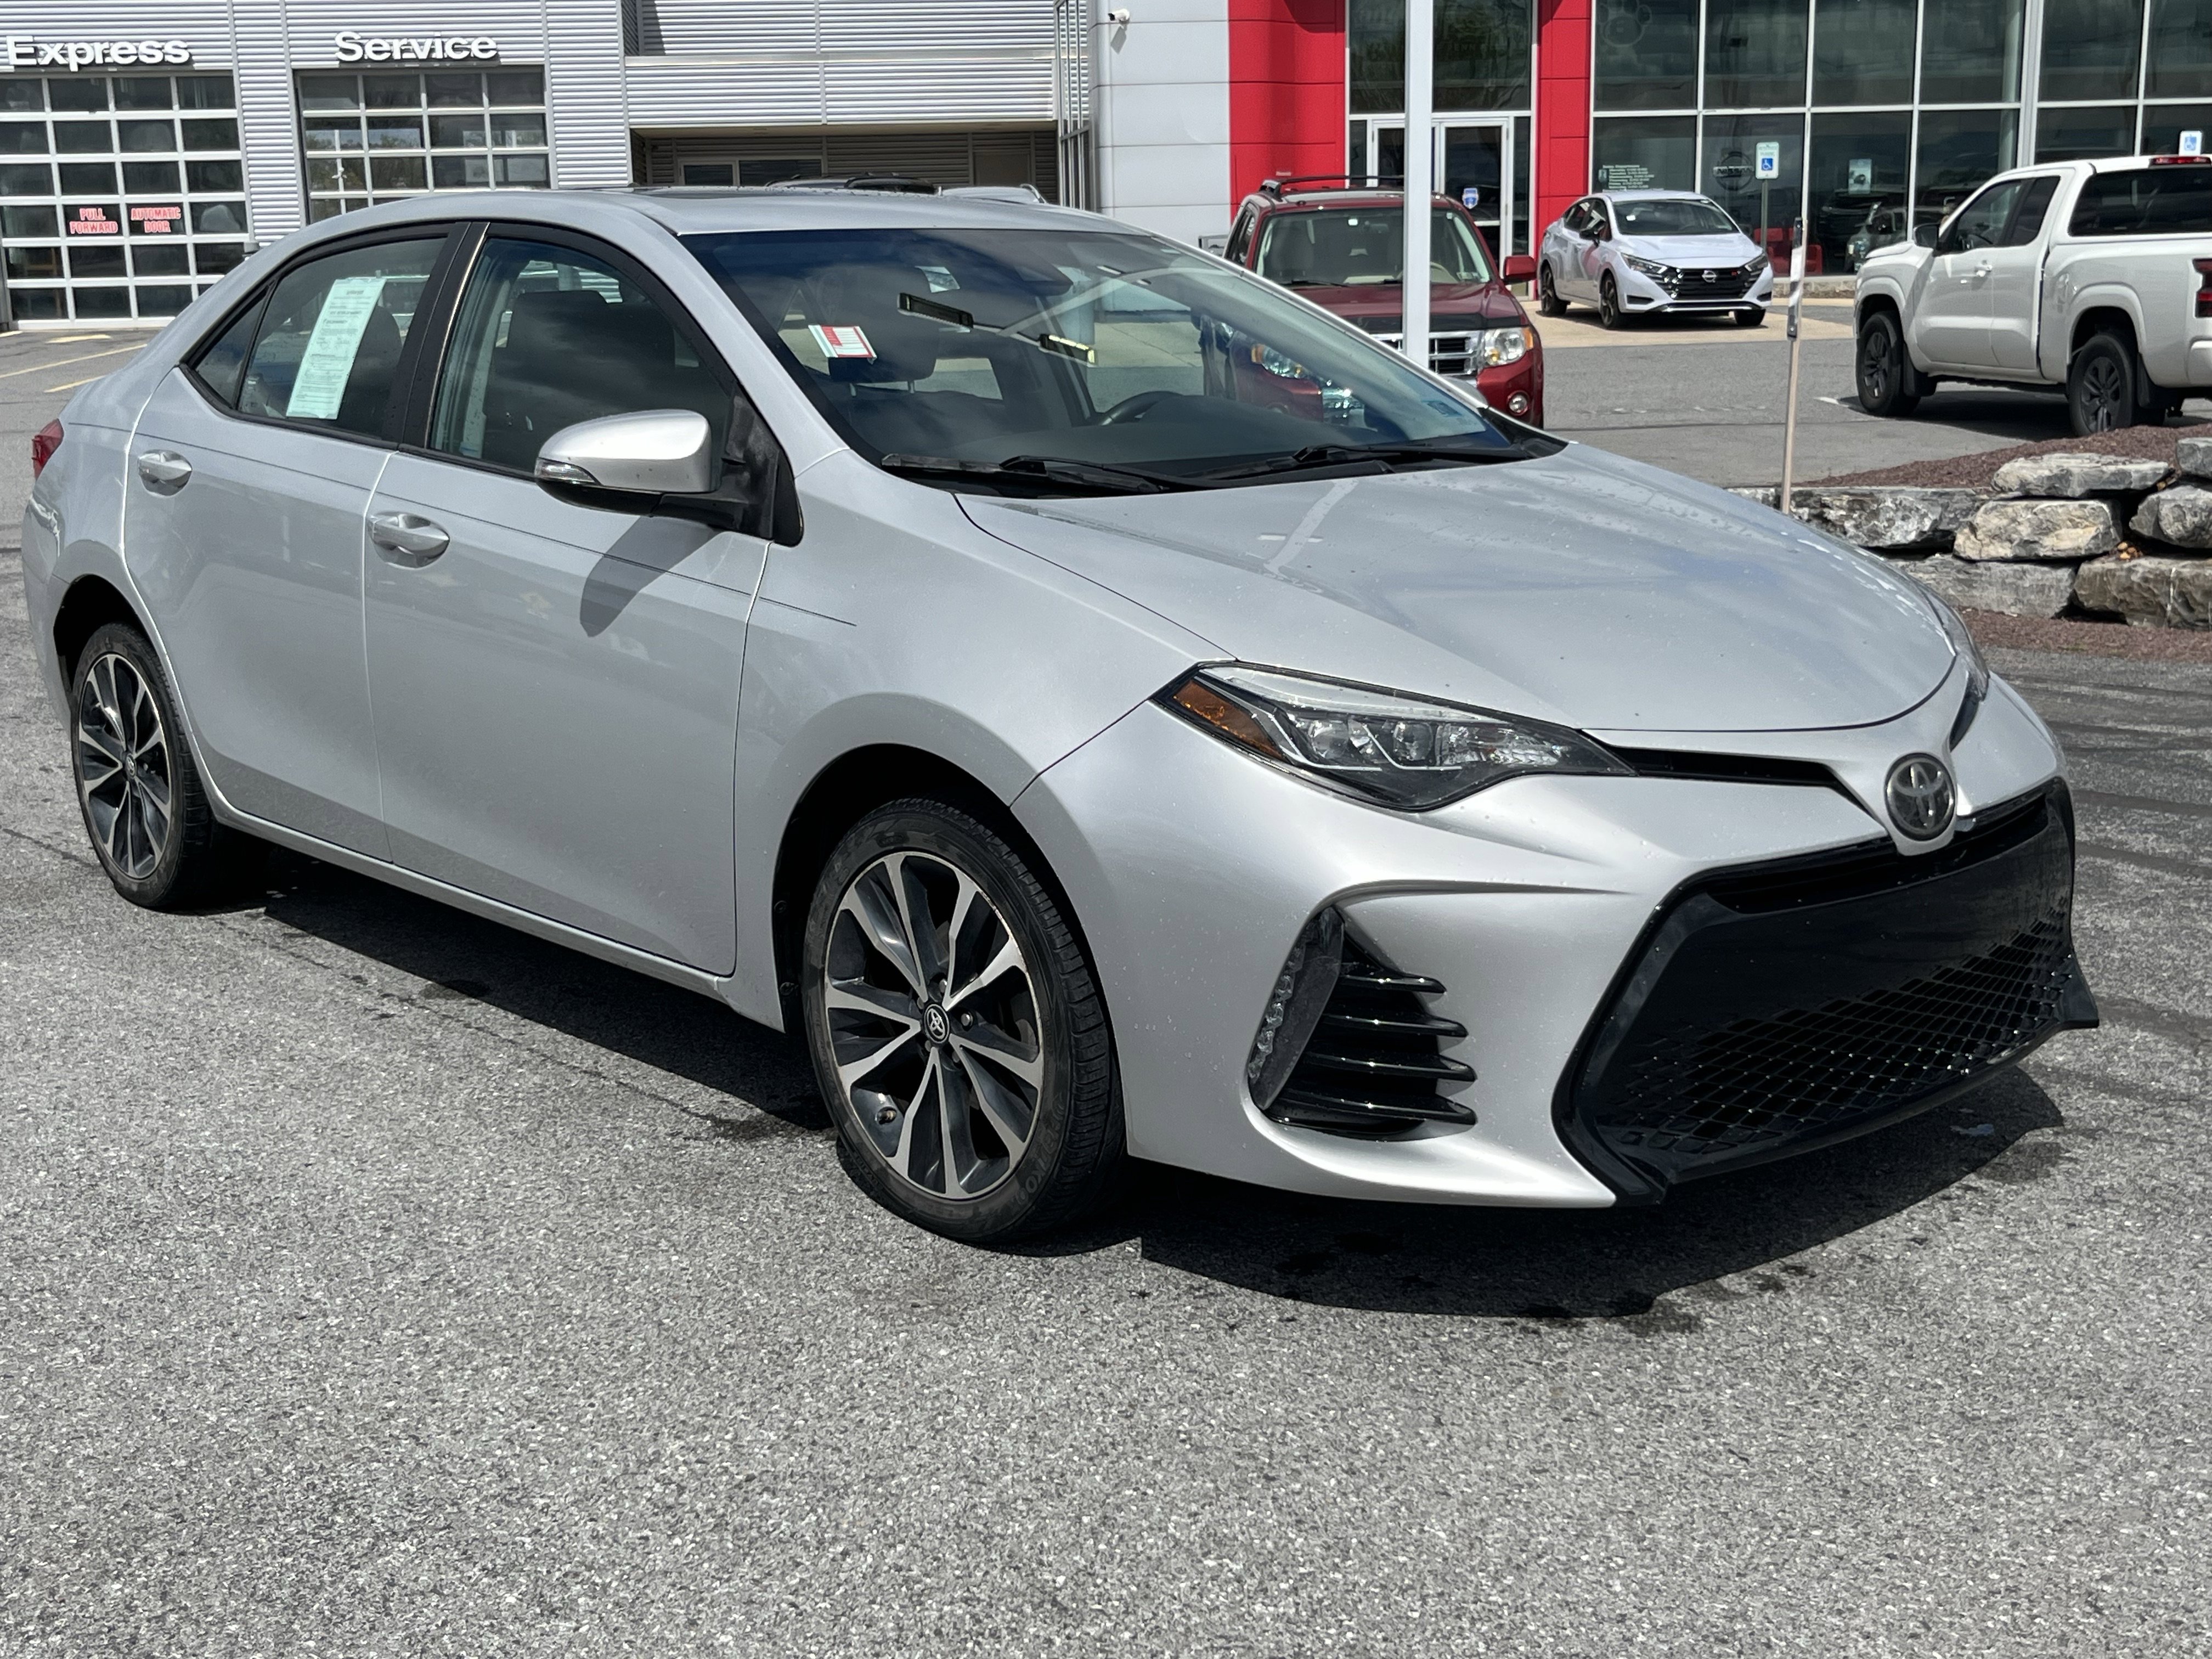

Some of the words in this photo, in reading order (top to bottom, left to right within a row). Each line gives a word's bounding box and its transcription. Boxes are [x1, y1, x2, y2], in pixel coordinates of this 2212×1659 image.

[335, 31, 497, 61] Service
[6, 36, 190, 72] Express
[80, 208, 106, 221] PULL
[131, 207, 181, 221] AUTOMATIC
[70, 221, 118, 234] FORWARD
[144, 221, 171, 233] DOOR
